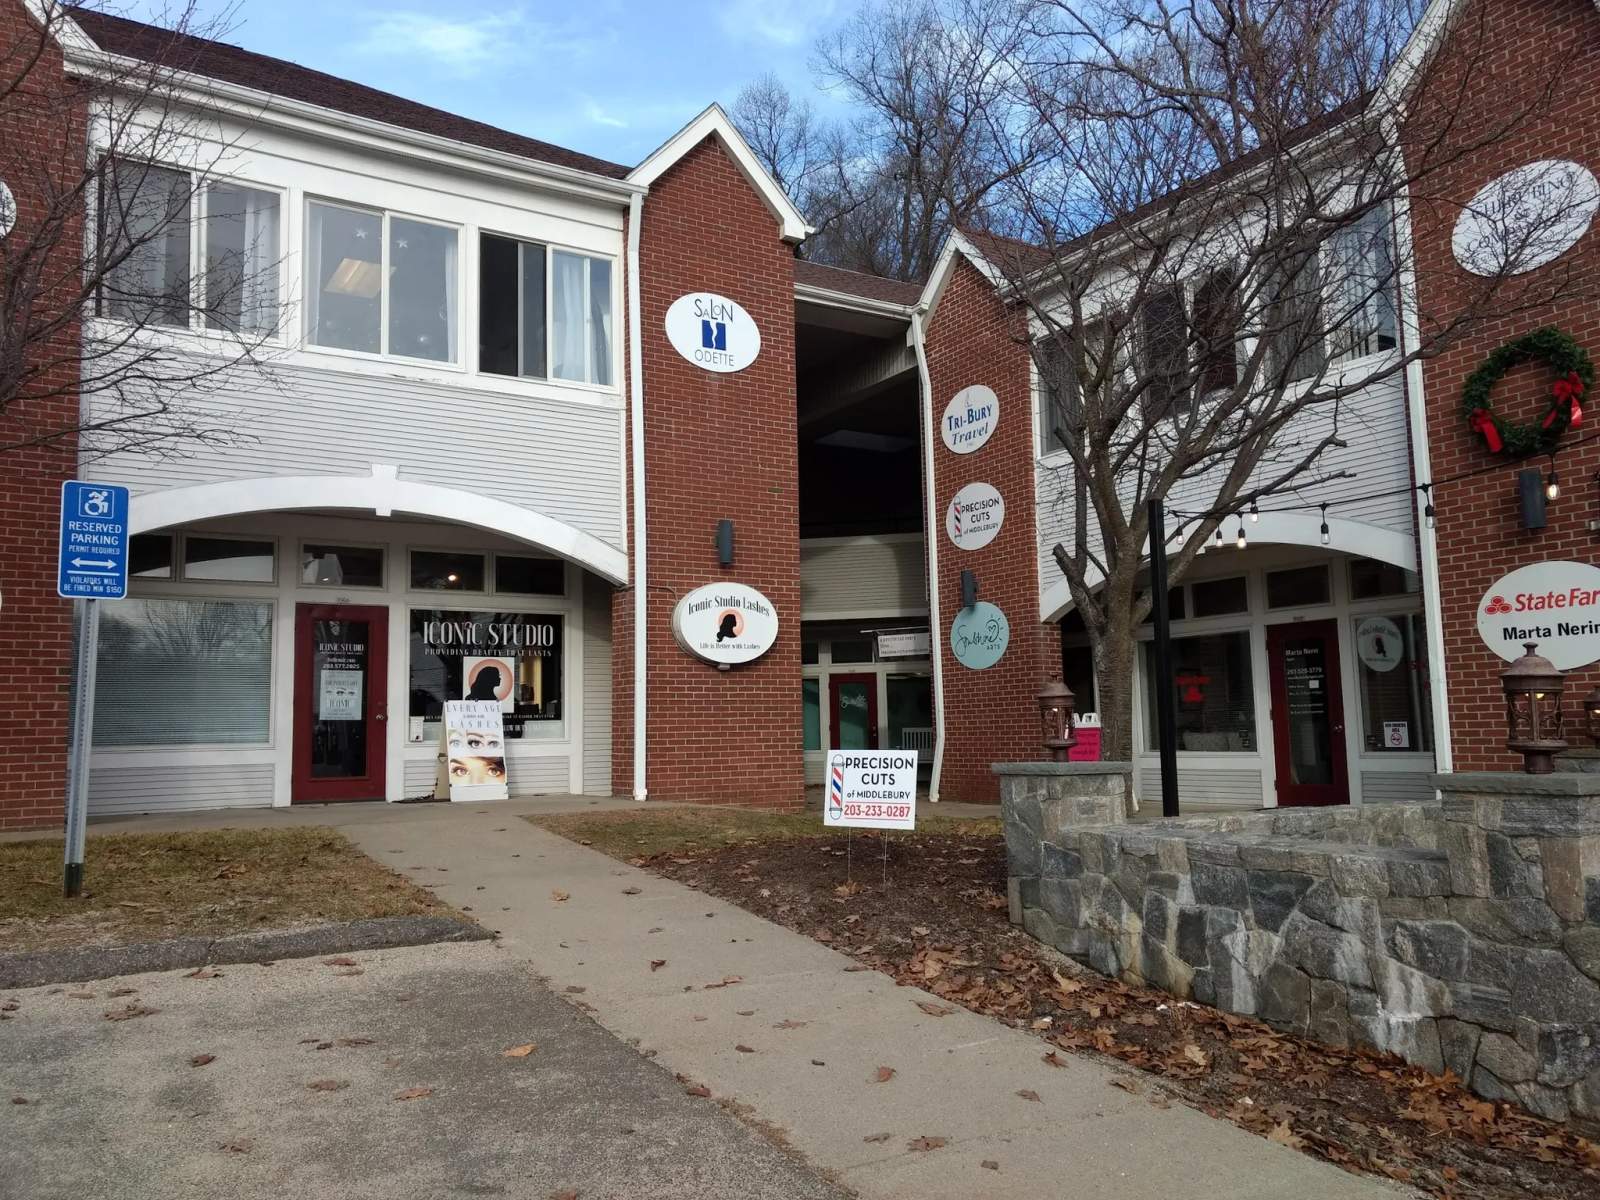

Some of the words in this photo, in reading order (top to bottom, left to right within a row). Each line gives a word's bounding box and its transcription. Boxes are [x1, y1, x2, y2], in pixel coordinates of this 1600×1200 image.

[694, 349, 735, 367] ODETTE
[952, 422, 989, 446] Travel
[961, 497, 1000, 514] PRECISION
[970, 511, 991, 524] CUTS
[68, 520, 122, 534] RESERVED
[71, 533, 119, 546] PARKING
[68, 545, 90, 553] PERMIT
[91, 546, 121, 555] REQUIRED
[69, 576, 102, 585] VIOLATORS
[103, 577, 118, 586] WILL
[63, 583, 72, 591] BE
[73, 584, 91, 592] FINED
[92, 585, 104, 593] MIN
[688, 597, 712, 615] Iconic
[714, 595, 741, 608] Studio
[743, 596, 770, 617] Lashes
[488, 623, 554, 647] STUDIO
[1503, 626, 1552, 641] Marta
[425, 648, 469, 656] PROVIDING
[472, 648, 502, 656] BEAUTY
[446, 703, 479, 713] EVERY
[450, 720, 499, 729] LASHES
[845, 757, 914, 769] PRECISION
[861, 773, 896, 786] CUTS
[846, 789, 855, 798] of
[856, 790, 911, 800] MIDDLEBURY
[844, 804, 911, 817] 203-233-0287
